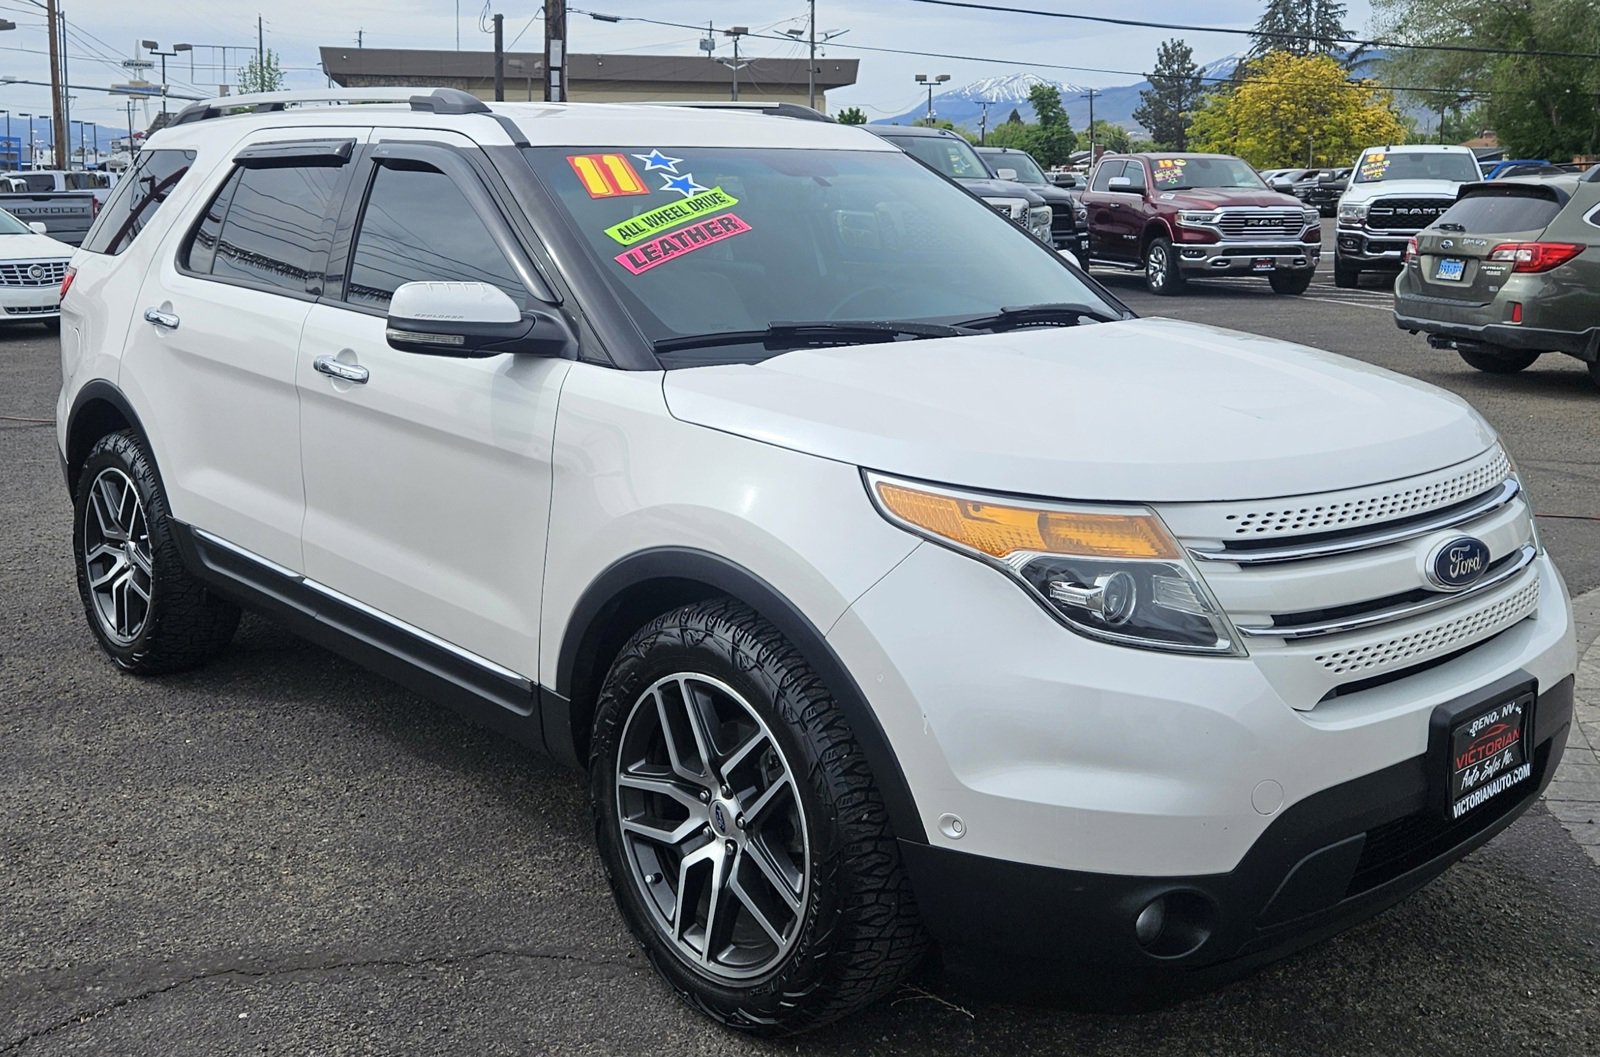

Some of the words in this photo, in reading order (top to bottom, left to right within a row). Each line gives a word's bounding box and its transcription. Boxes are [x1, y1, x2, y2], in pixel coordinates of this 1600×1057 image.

[574, 155, 641, 195] 11
[617, 220, 645, 240] ALL
[644, 205, 690, 228] WHEEL
[687, 192, 726, 212] DRIVE
[625, 216, 739, 269] LEATHER
[1450, 545, 1482, 578] Ford
[1472, 711, 1499, 731] RENO,
[1502, 702, 1516, 717] NV
[1456, 728, 1520, 769] VICTORIAN
[1453, 763, 1531, 819] VICTORIANAUTO.COM
[1461, 765, 1480, 791] Auto
[1480, 757, 1502, 782] Sales
